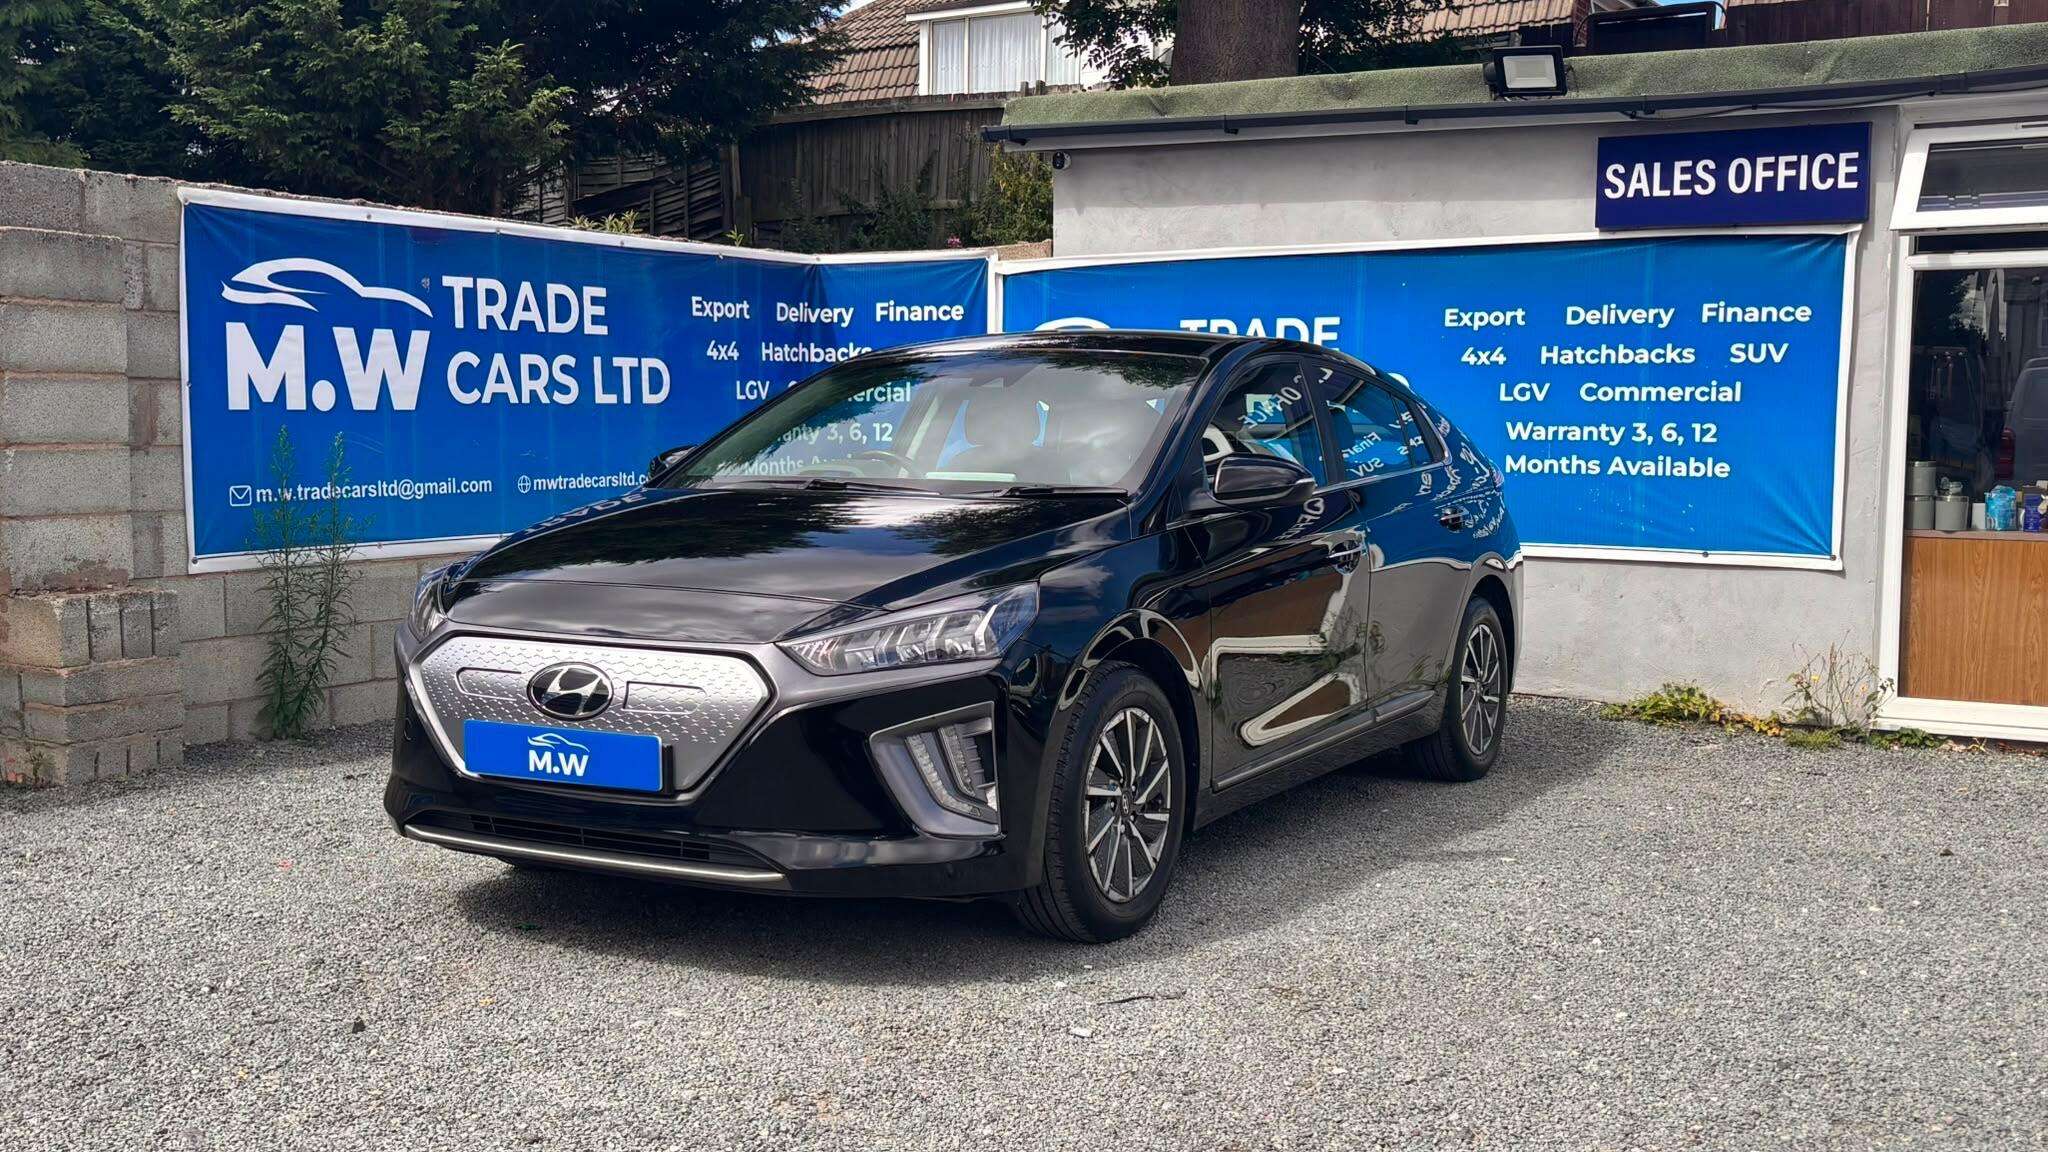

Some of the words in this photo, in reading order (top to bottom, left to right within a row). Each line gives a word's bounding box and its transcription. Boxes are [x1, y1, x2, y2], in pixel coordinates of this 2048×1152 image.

[1604, 159, 1716, 199] SALES
[1727, 151, 1859, 194] OFFICE
[442, 275, 609, 335] TRADE
[691, 296, 750, 322] Export
[776, 302, 854, 328] Delivery
[875, 301, 965, 322] Finance
[1444, 308, 1526, 329] Export
[1566, 304, 1675, 328] Delivery
[1701, 301, 1812, 323] Finance
[1180, 317, 1341, 351] ADE
[706, 340, 740, 361] 4x4
[1461, 346, 1507, 366] 4x4
[1540, 343, 1696, 365] Hatchbacks
[1729, 343, 1789, 363] SUV
[225, 321, 431, 412] M.W
[446, 351, 579, 405] CARS
[593, 356, 671, 404] LTD
[736, 380, 770, 401] LGV
[1500, 382, 1551, 401] LGV
[1579, 381, 1742, 402] Commercial
[827, 423, 844, 442] 3,
[849, 423, 868, 444] 6,
[872, 422, 893, 442] 12
[1506, 421, 1626, 446] Warranty
[1631, 422, 1654, 445] 3,
[1661, 422, 1684, 446] 6,
[1691, 423, 1717, 443] 12
[1505, 454, 1601, 476] Months
[1607, 455, 1731, 478] Available
[255, 477, 493, 503] m.w.tradecarsltd@gmail.com
[528, 749, 589, 777] M.W
